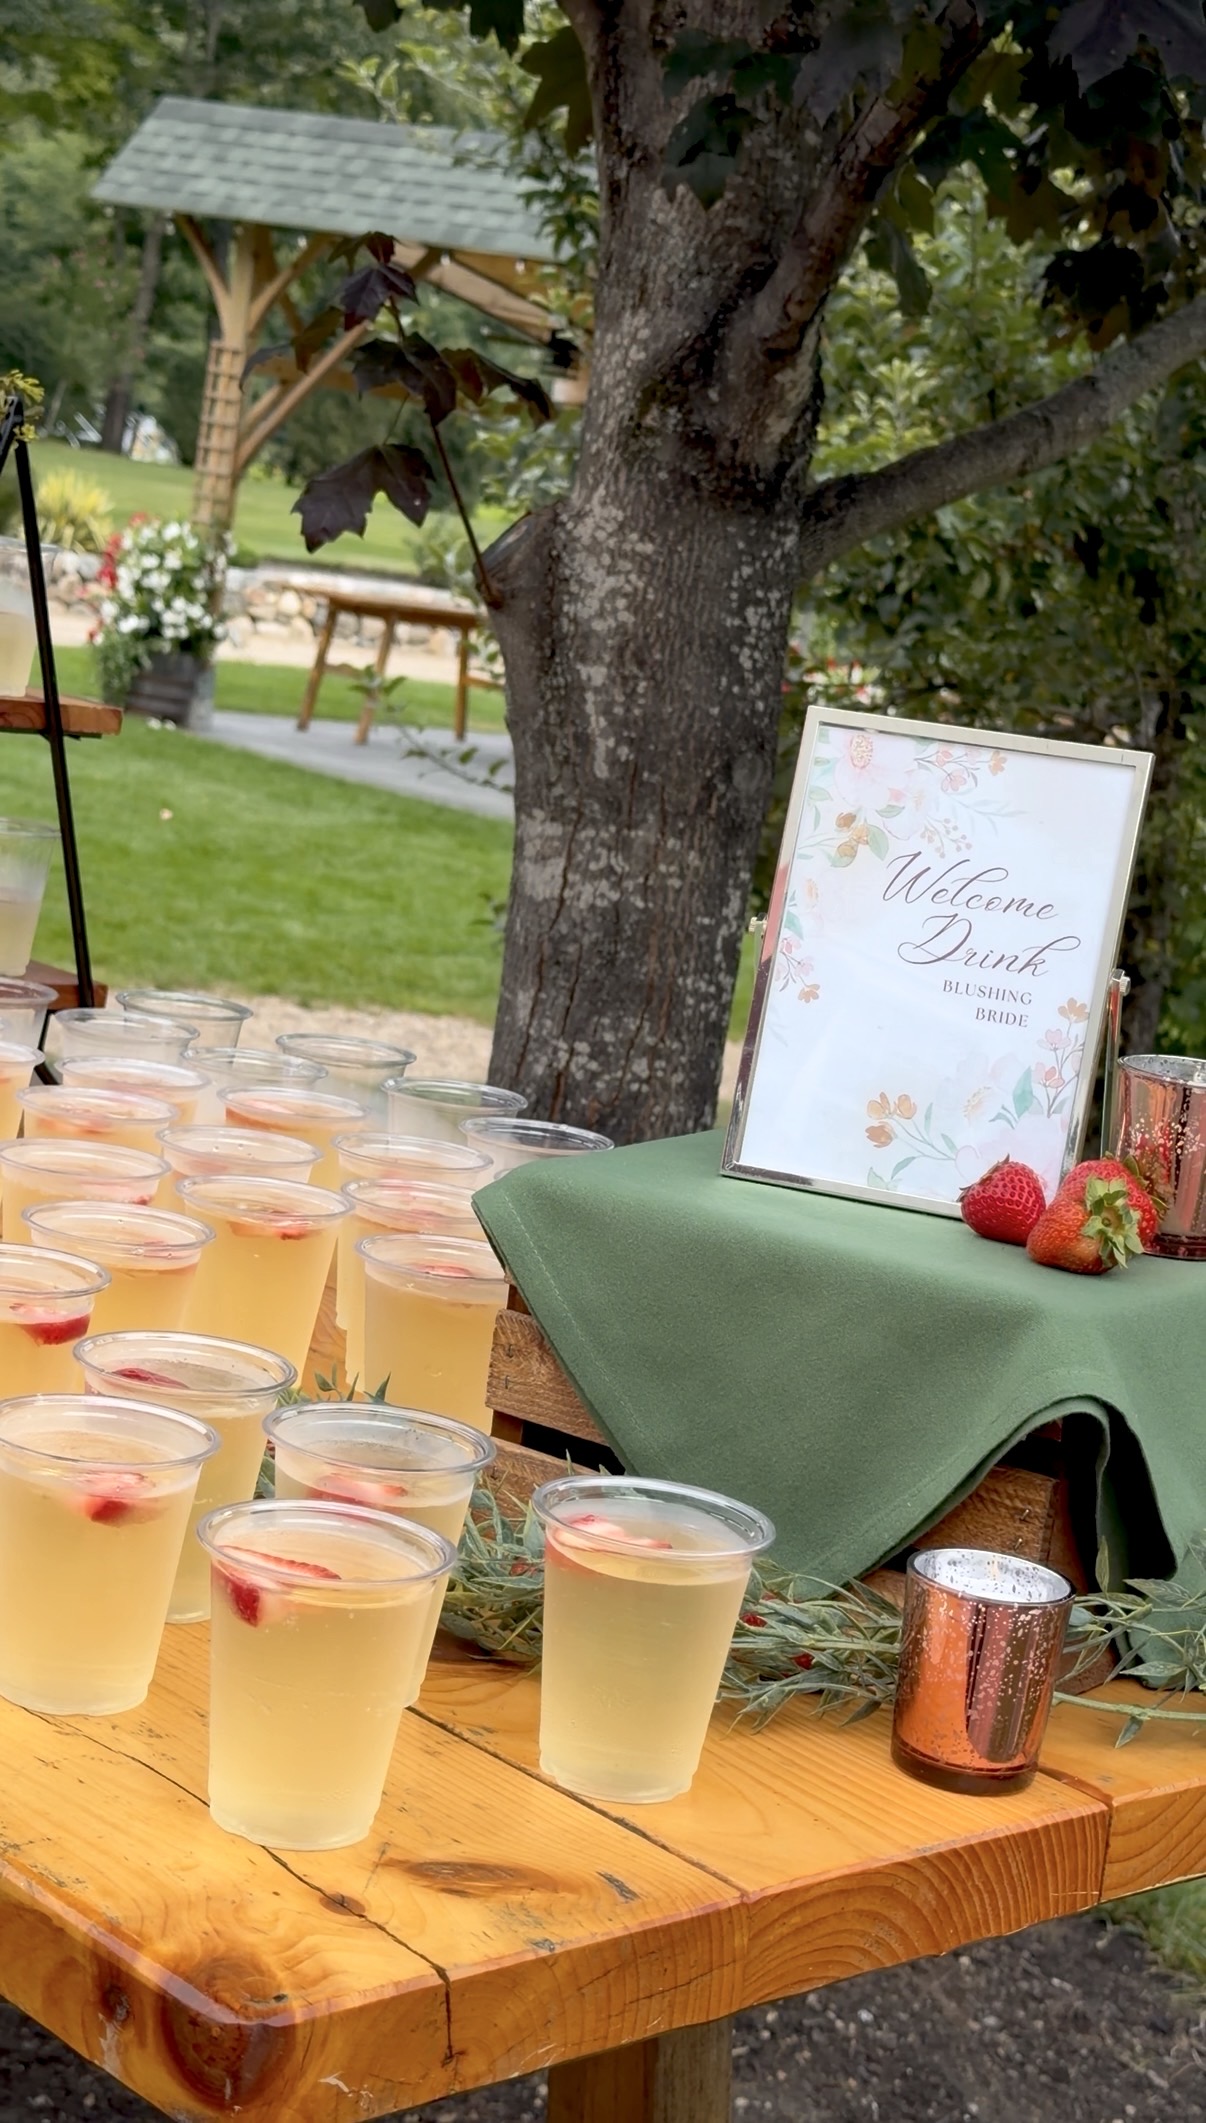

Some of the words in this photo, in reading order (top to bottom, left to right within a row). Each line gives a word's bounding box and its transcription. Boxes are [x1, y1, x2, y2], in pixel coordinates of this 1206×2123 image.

[883, 851, 1059, 920] Welcome
[898, 913, 1081, 977] Drink
[943, 979, 1033, 1006] BLUSHING
[975, 1007, 1029, 1028] BRIDE
